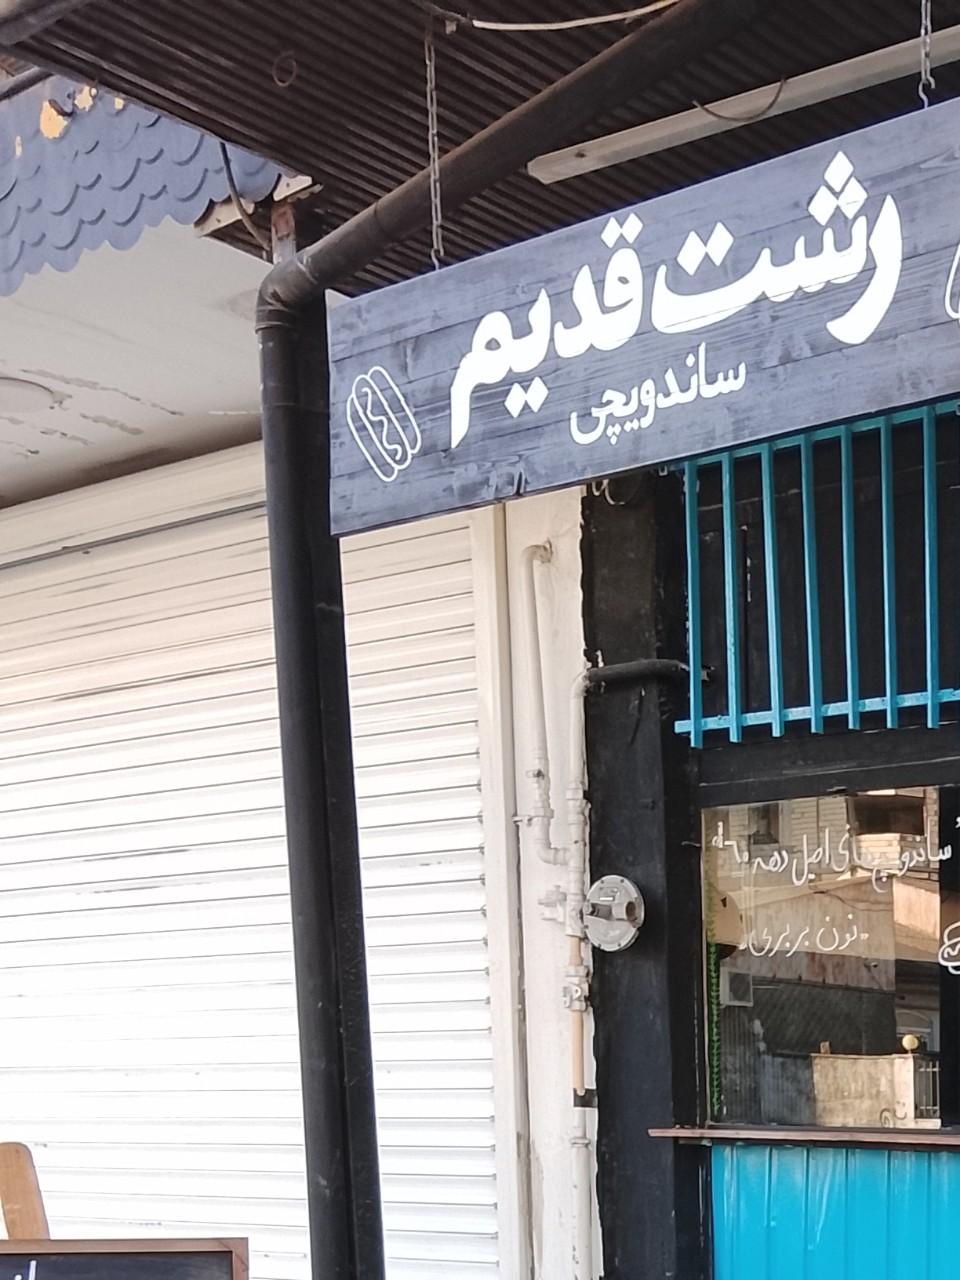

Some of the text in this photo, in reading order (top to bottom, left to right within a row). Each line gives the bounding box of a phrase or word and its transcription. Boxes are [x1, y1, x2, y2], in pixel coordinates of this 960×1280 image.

[450, 150, 903, 448] رشت قدیم
[568, 342, 746, 446] ساندویچی
